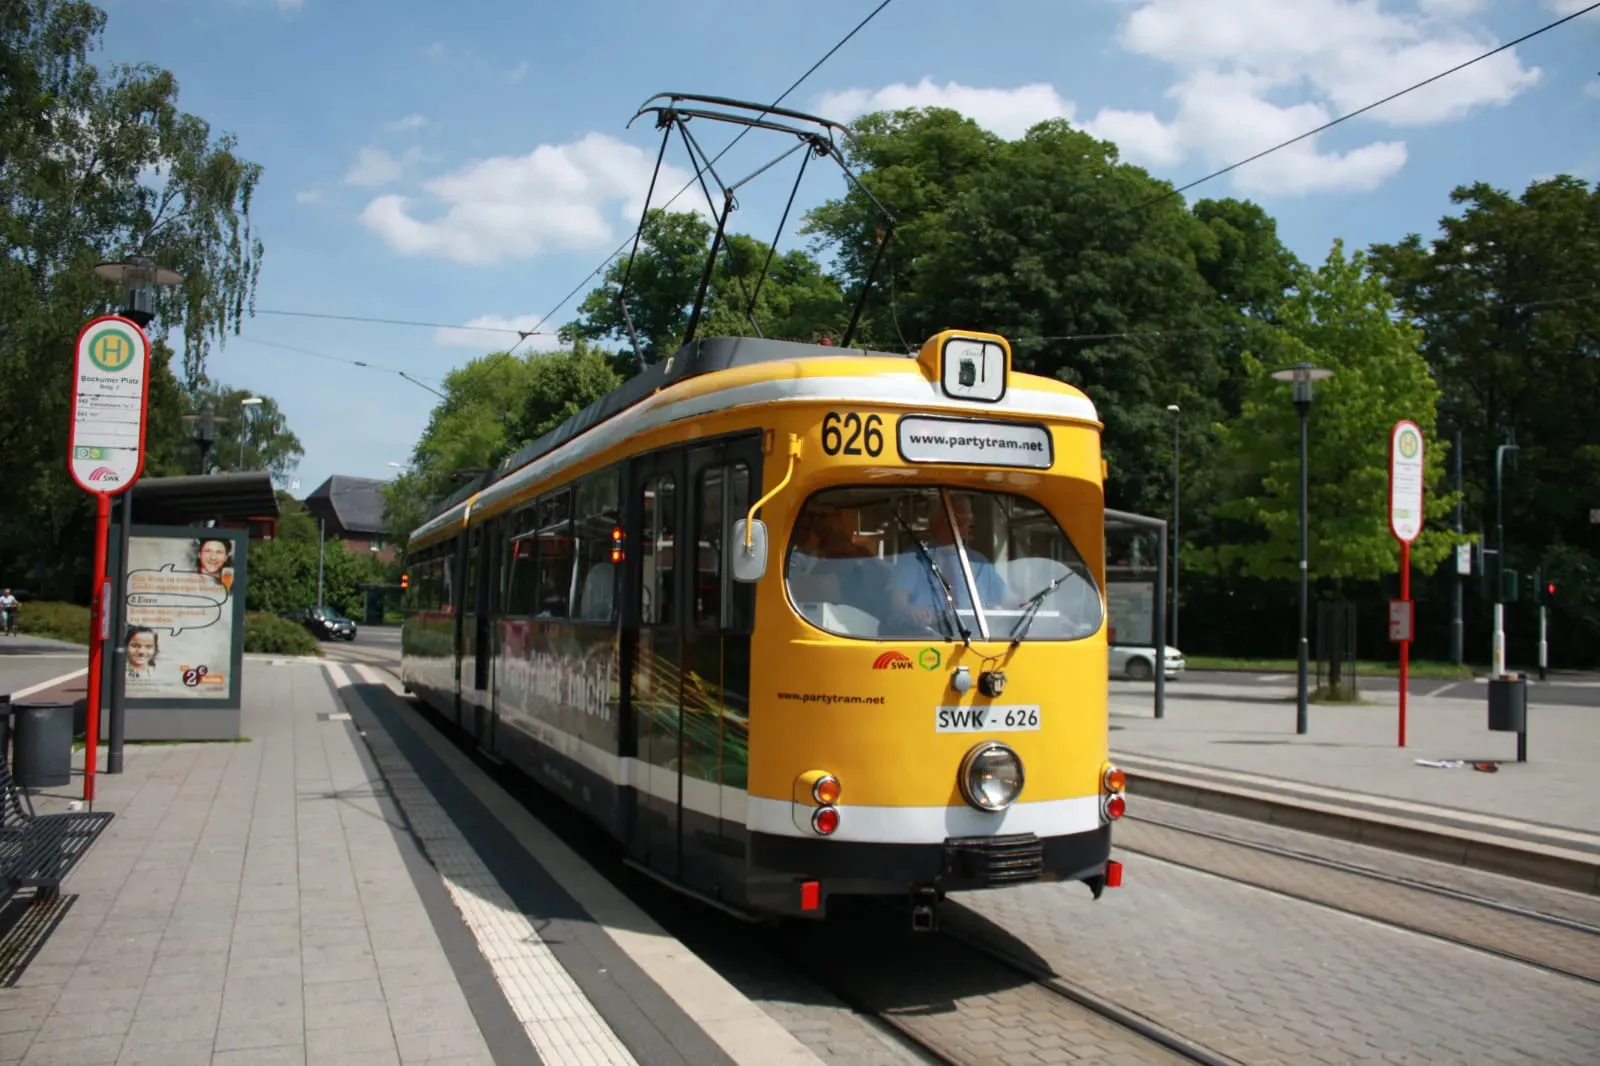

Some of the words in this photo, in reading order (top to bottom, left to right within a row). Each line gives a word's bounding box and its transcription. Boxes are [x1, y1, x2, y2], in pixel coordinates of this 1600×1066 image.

[102, 338, 122, 363] H
[81, 375, 119, 384] Bockumer
[121, 376, 139, 385] Platz
[821, 411, 884, 458] 626
[909, 432, 1044, 453] www.partytram.net
[103, 474, 120, 482] SWK
[138, 596, 158, 604] Euro
[890, 661, 914, 670] SWK
[777, 690, 885, 706] www.partytram.net
[938, 710, 984, 728] SWK
[1004, 709, 1038, 727] 626
